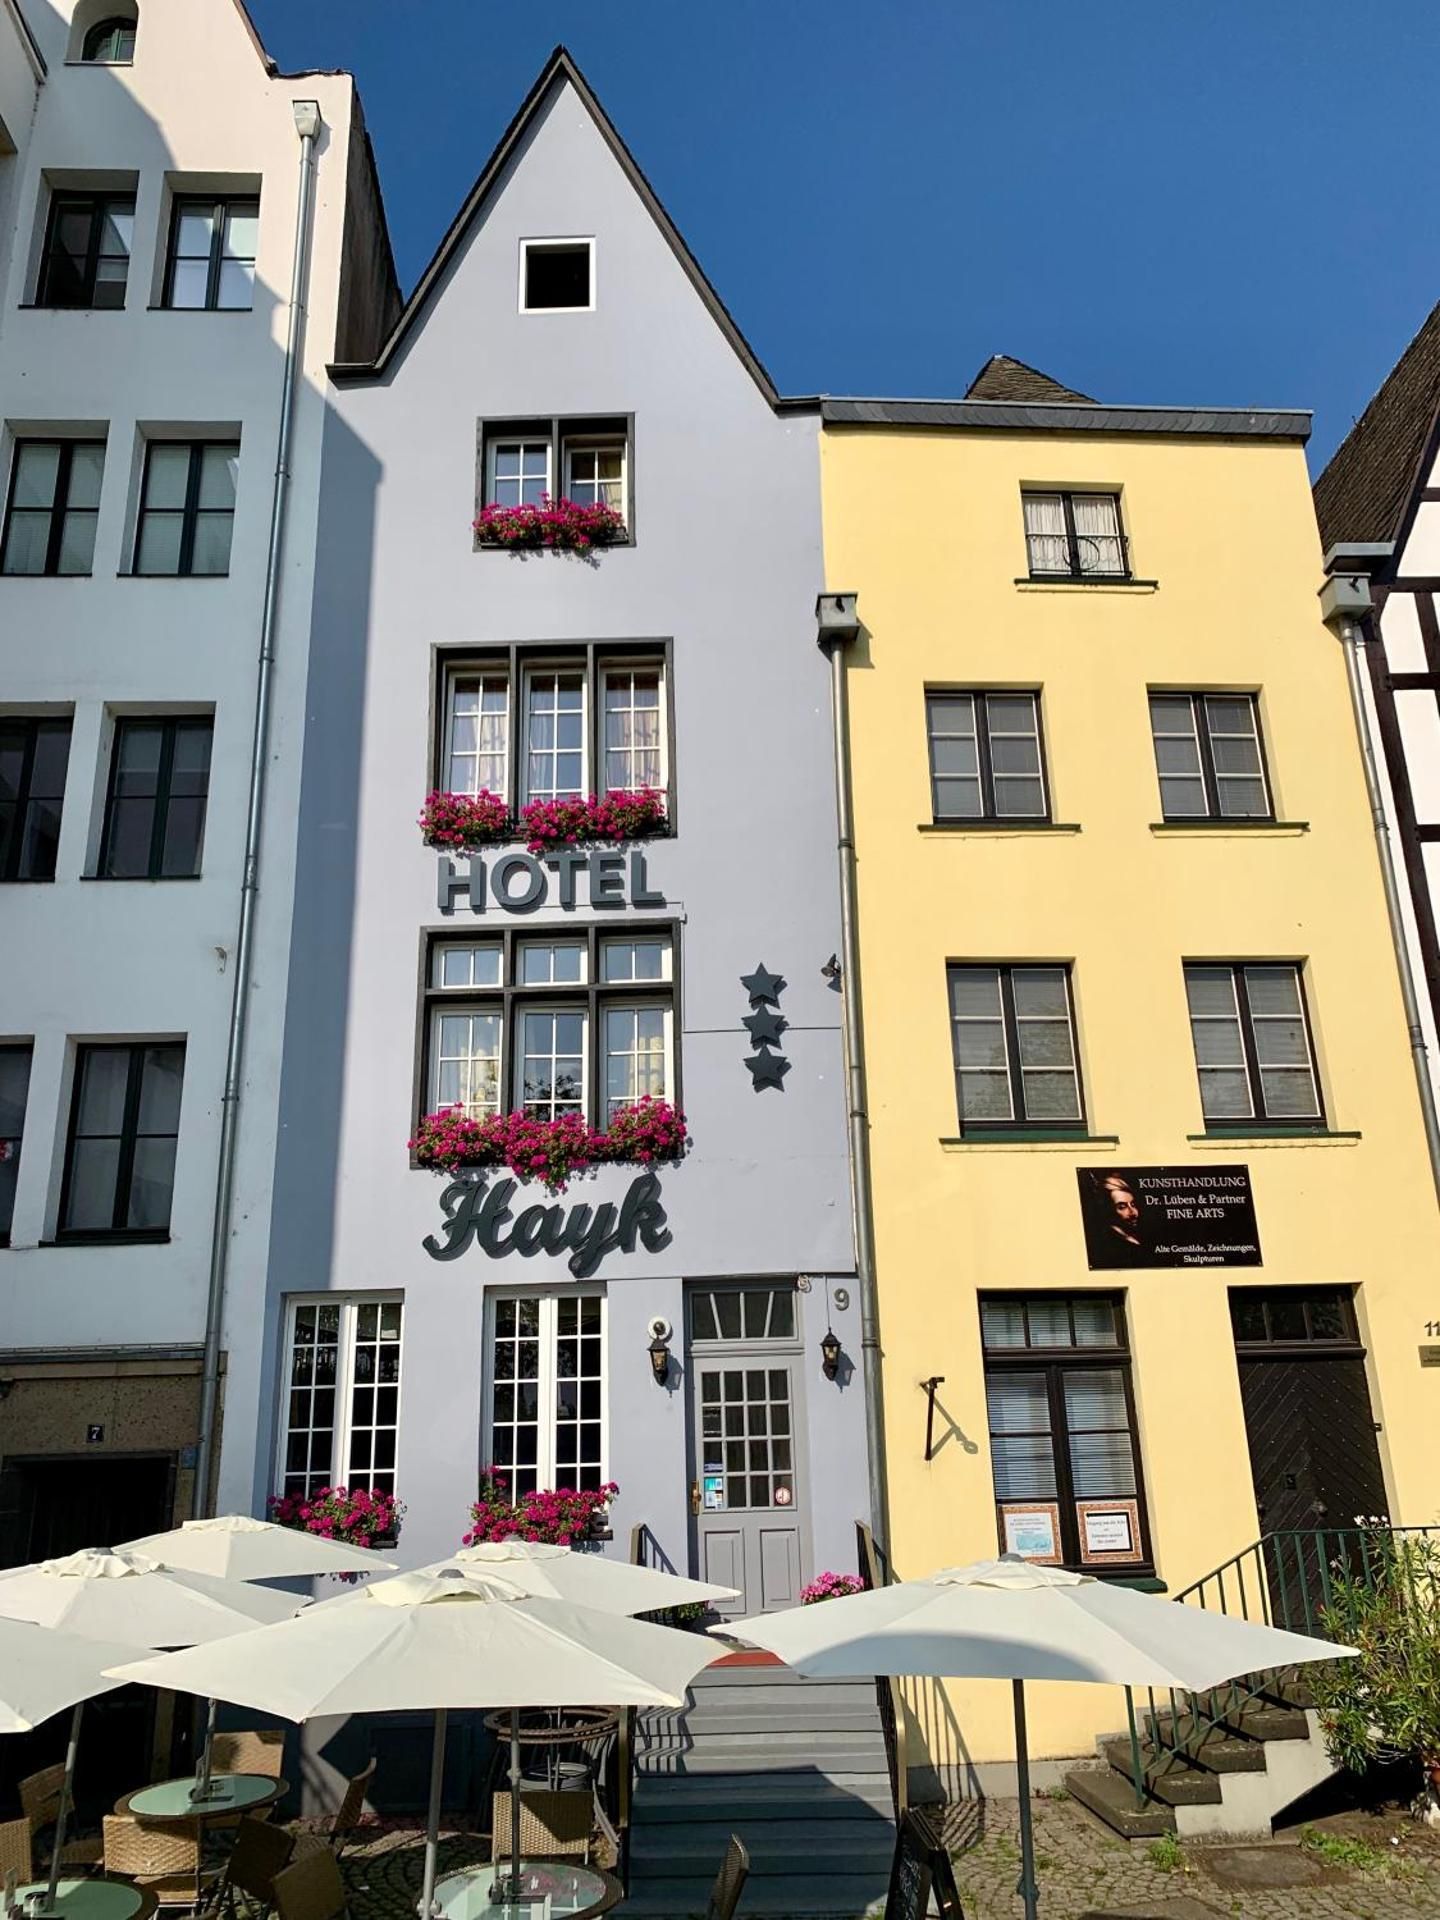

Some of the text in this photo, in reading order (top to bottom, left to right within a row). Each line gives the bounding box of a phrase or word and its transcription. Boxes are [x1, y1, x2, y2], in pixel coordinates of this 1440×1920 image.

[437, 850, 663, 912] HOTEL
[1139, 1177, 1246, 1188] KUNSTHANDLUNG
[1145, 1193, 1246, 1205] Dr. Lüben & Partner
[1166, 1207, 1225, 1219] FINE ARTS
[422, 1172, 672, 1278] Hayk
[1155, 1245, 1171, 1254] Alte
[1183, 1255, 1225, 1265] Skulpturen
[834, 1288, 850, 1311] 9
[91, 1427, 101, 1440] 7
